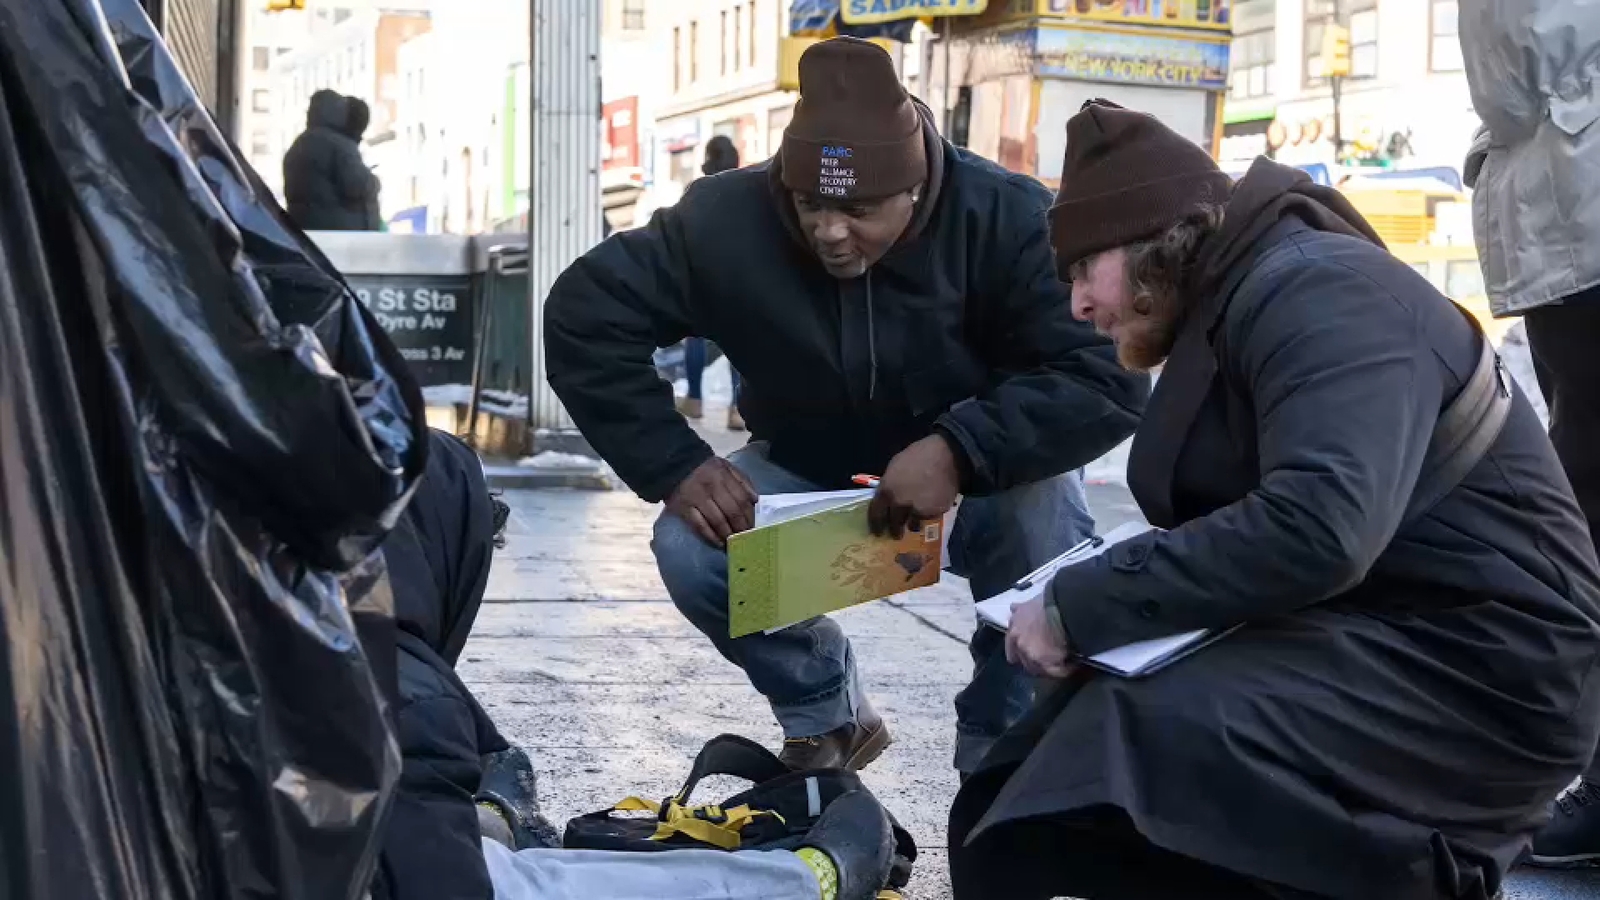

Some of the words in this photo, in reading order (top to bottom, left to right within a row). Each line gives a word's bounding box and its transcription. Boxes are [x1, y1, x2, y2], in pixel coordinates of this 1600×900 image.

[1065, 52, 1108, 76] NEW
[1109, 58, 1160, 80] YORK
[1162, 64, 1201, 85] CITY
[821, 157, 839, 166] PEER
[820, 167, 855, 177] ALLIANCE
[819, 176, 857, 186] RECOVERY
[819, 186, 848, 196] CENTER
[378, 287, 406, 311] St
[413, 287, 457, 312] Sta
[374, 312, 417, 333] Dyre
[421, 312, 446, 330] Av
[431, 345, 442, 361] 3
[444, 346, 465, 361] Av
